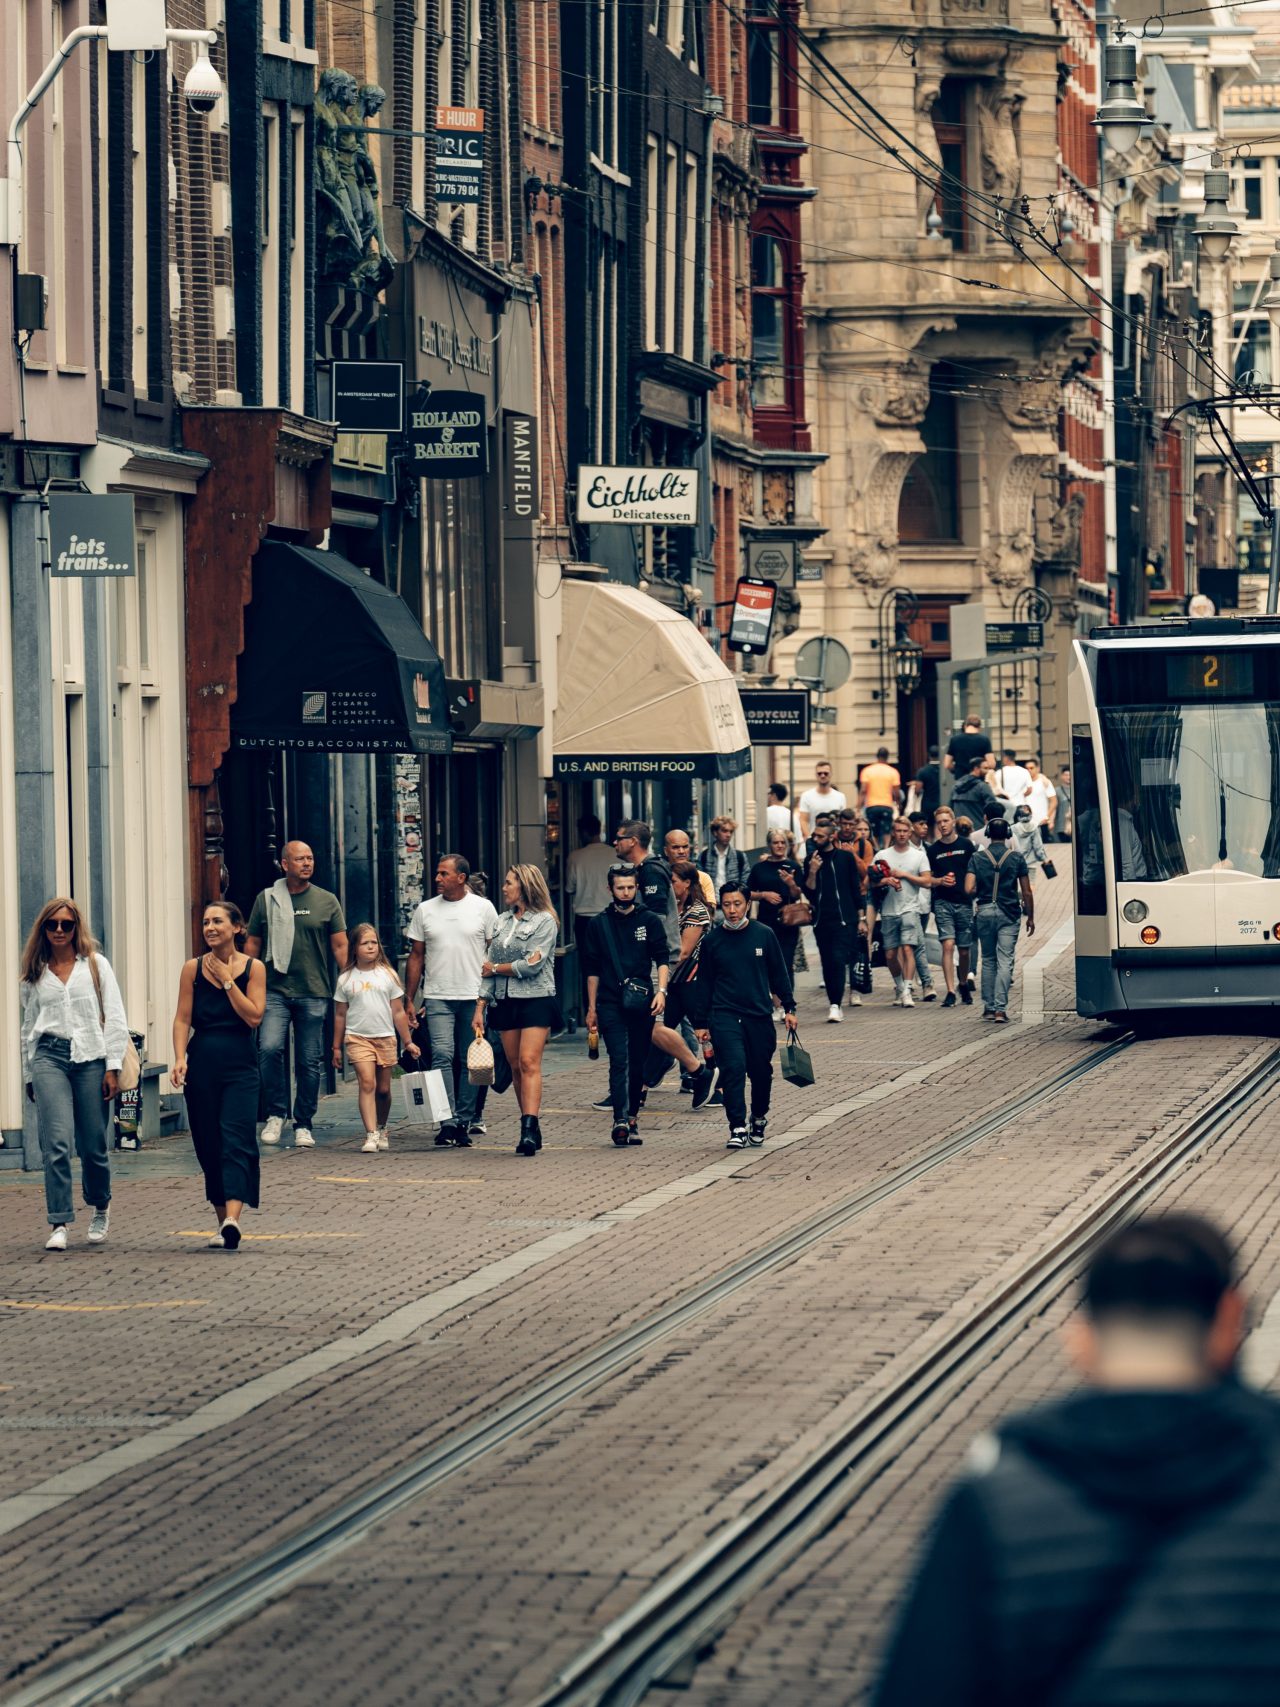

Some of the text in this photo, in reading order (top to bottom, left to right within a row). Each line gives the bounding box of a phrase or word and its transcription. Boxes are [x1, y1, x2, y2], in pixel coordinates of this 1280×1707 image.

[446, 110, 477, 127] HUUR
[441, 184, 456, 195] 775
[457, 184, 467, 196] 79
[468, 186, 479, 197] 04
[411, 411, 481, 428] HOLLAND
[441, 427, 455, 443] &
[414, 442, 480, 459] BARRETT
[512, 420, 532, 516] MANFIELD
[586, 472, 690, 509] Eichholtz
[612, 508, 691, 521] Delicatessen
[69, 534, 106, 555] iets
[57, 551, 129, 571] frans...
[1203, 655, 1219, 687] 2
[746, 710, 800, 719] ODYCULT
[240, 739, 408, 748] DUTCHTOBACCONIST.NL
[558, 761, 696, 772] U.S. AND BRITISH FOOD
